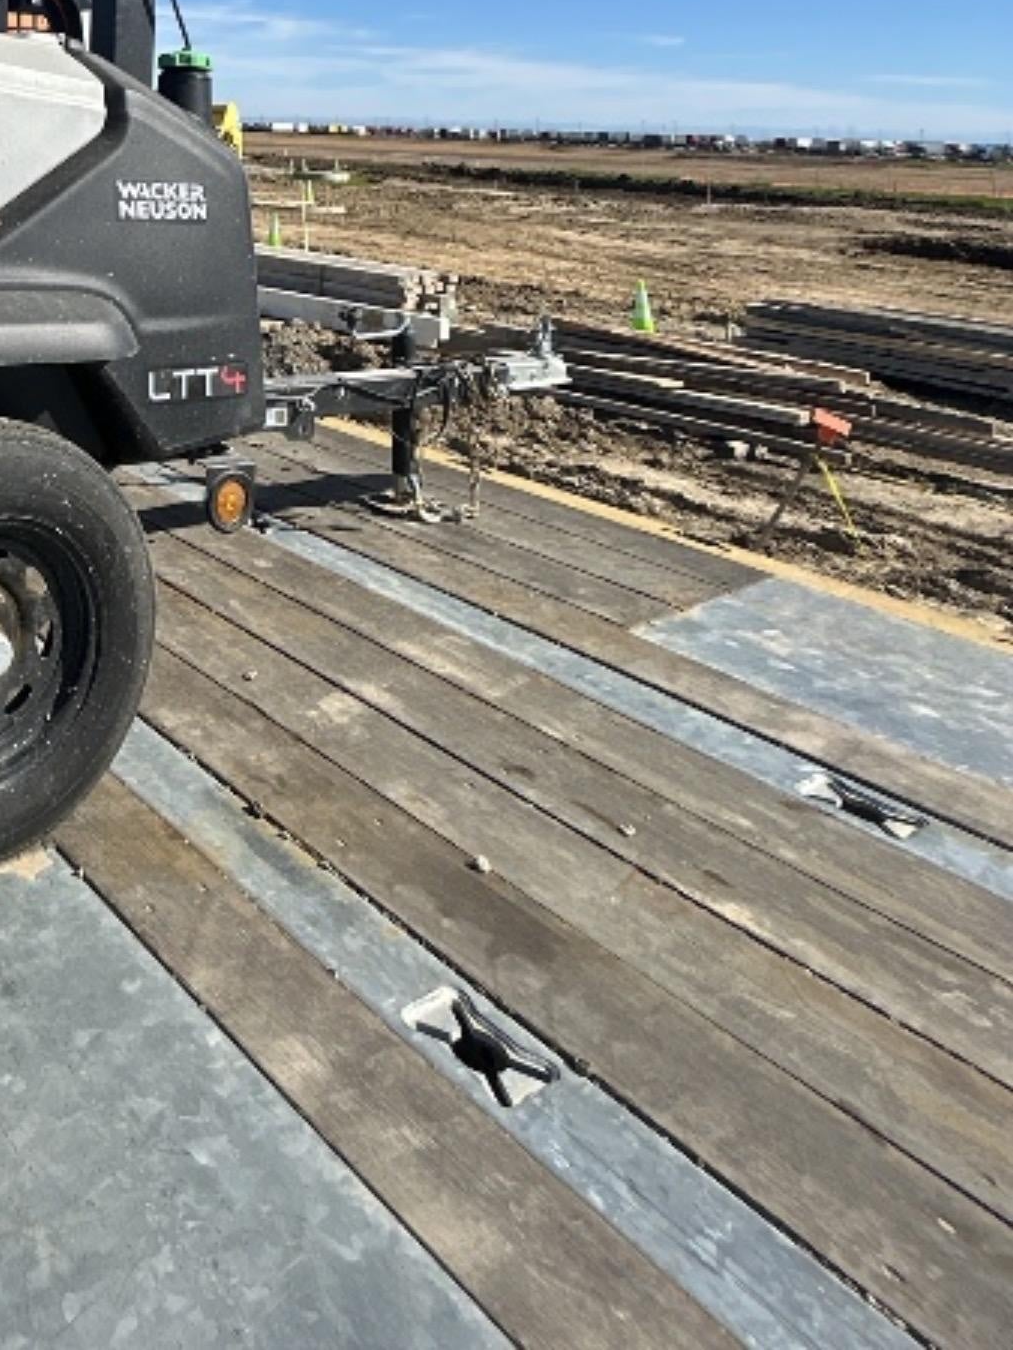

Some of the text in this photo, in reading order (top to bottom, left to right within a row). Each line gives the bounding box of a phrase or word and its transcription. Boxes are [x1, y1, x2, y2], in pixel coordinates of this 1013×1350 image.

[116, 179, 206, 202] WACKER
[118, 201, 208, 221] NEUSON
[147, 366, 247, 402] LTT4
